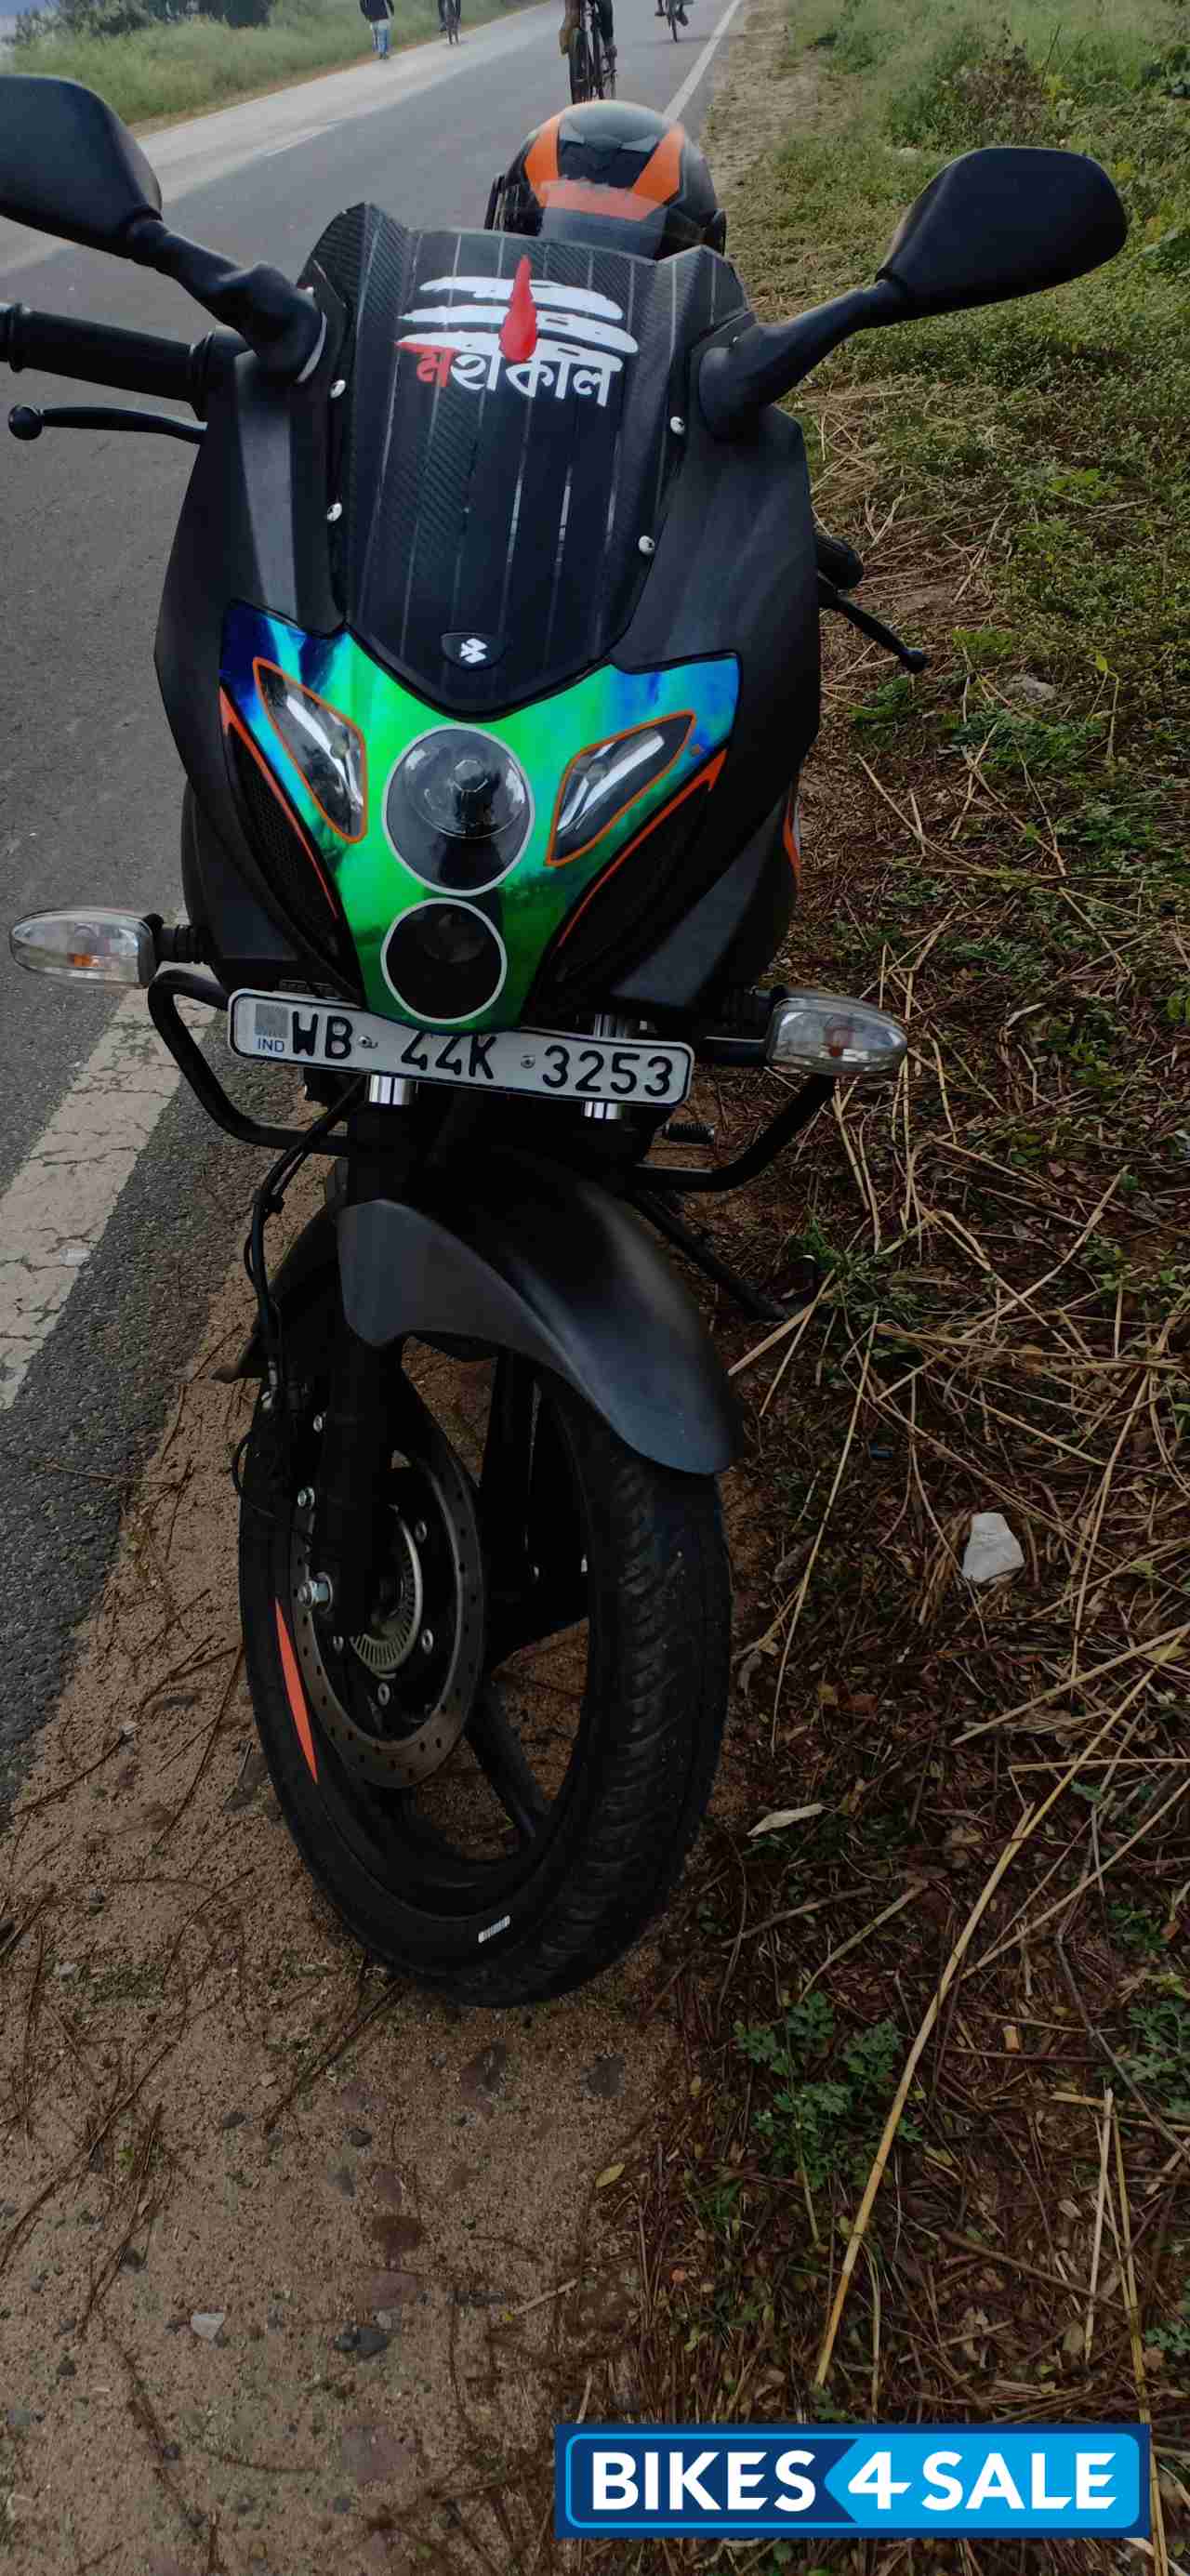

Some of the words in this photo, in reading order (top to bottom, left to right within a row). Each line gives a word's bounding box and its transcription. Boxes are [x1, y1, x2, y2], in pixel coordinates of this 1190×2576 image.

[395, 337, 624, 407] মহাকাল
[257, 1037, 285, 1053] IND
[292, 1011, 353, 1060] WB
[400, 1030, 497, 1080] 44K
[542, 1044, 673, 1097] 3253
